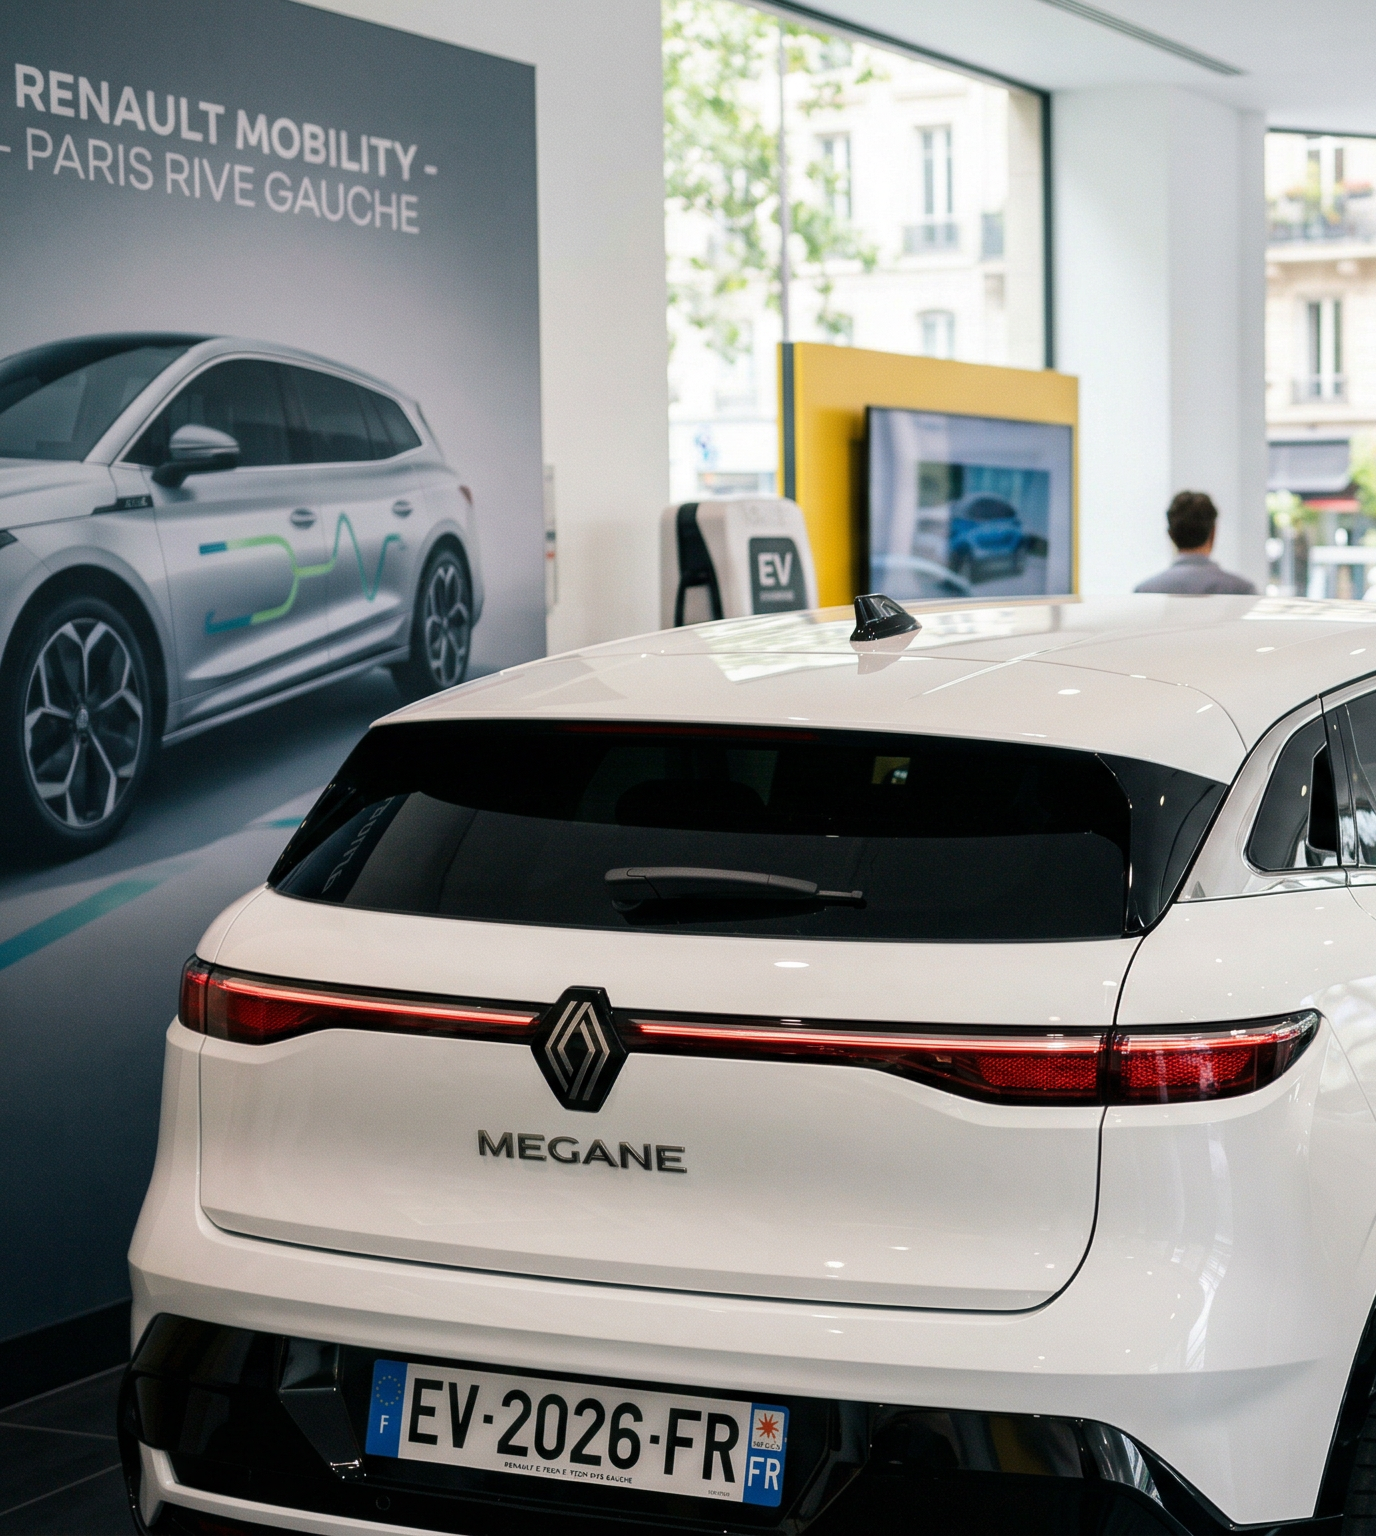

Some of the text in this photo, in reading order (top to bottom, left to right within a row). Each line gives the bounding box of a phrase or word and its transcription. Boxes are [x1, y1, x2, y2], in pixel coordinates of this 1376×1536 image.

[15, 63, 225, 145] RENAULT
[236, 108, 418, 182] MOBILITY
[26, 127, 154, 191] PARIS
[165, 152, 255, 208] RIVE
[264, 170, 420, 235] GAUCHE
[757, 552, 793, 587] EV
[477, 1129, 687, 1173] MEGANE
[380, 1414, 390, 1434] F
[748, 1456, 780, 1491] FR
